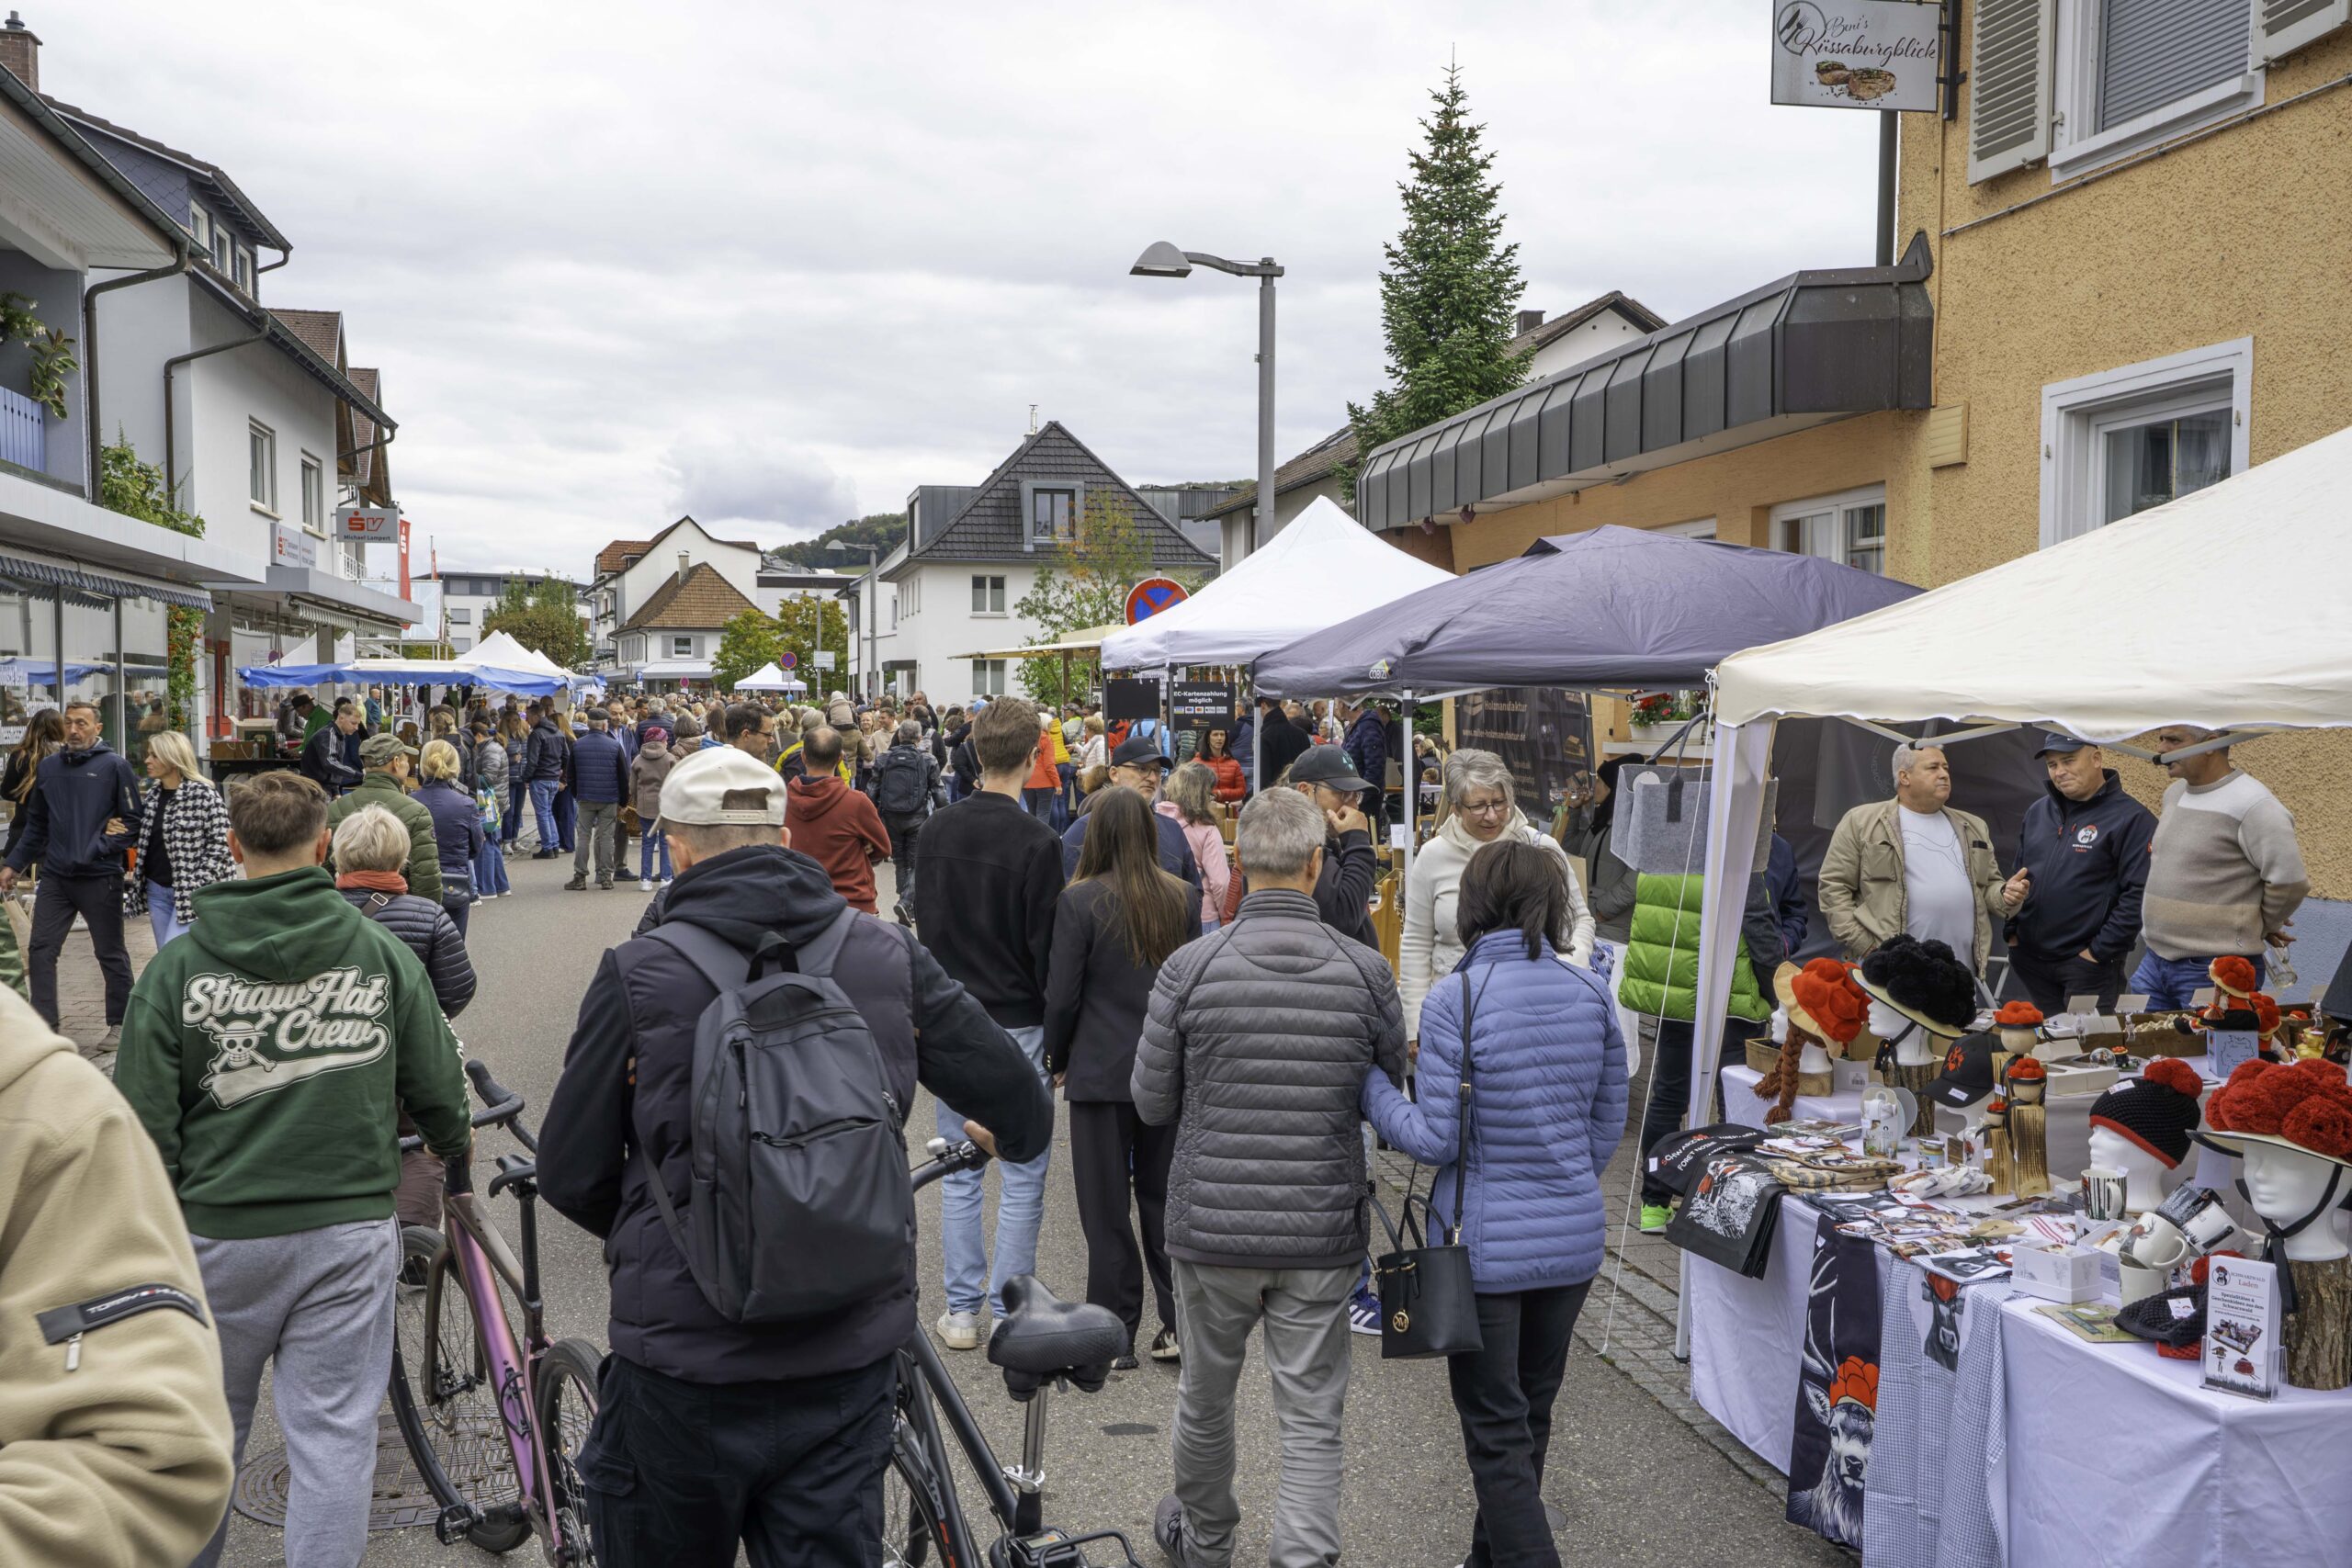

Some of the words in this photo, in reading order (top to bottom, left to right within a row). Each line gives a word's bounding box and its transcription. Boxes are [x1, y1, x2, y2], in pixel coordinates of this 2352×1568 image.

[1825, 15, 1869, 38] Beni's
[184, 976, 312, 1022] Straw
[308, 968, 386, 1014] Hat
[277, 1009, 373, 1052] Crew
[2238, 1279, 2258, 1289] Laden
[2211, 1295, 2245, 1306] Geschenkideen
[2222, 1303, 2253, 1314] Schwarzwald
